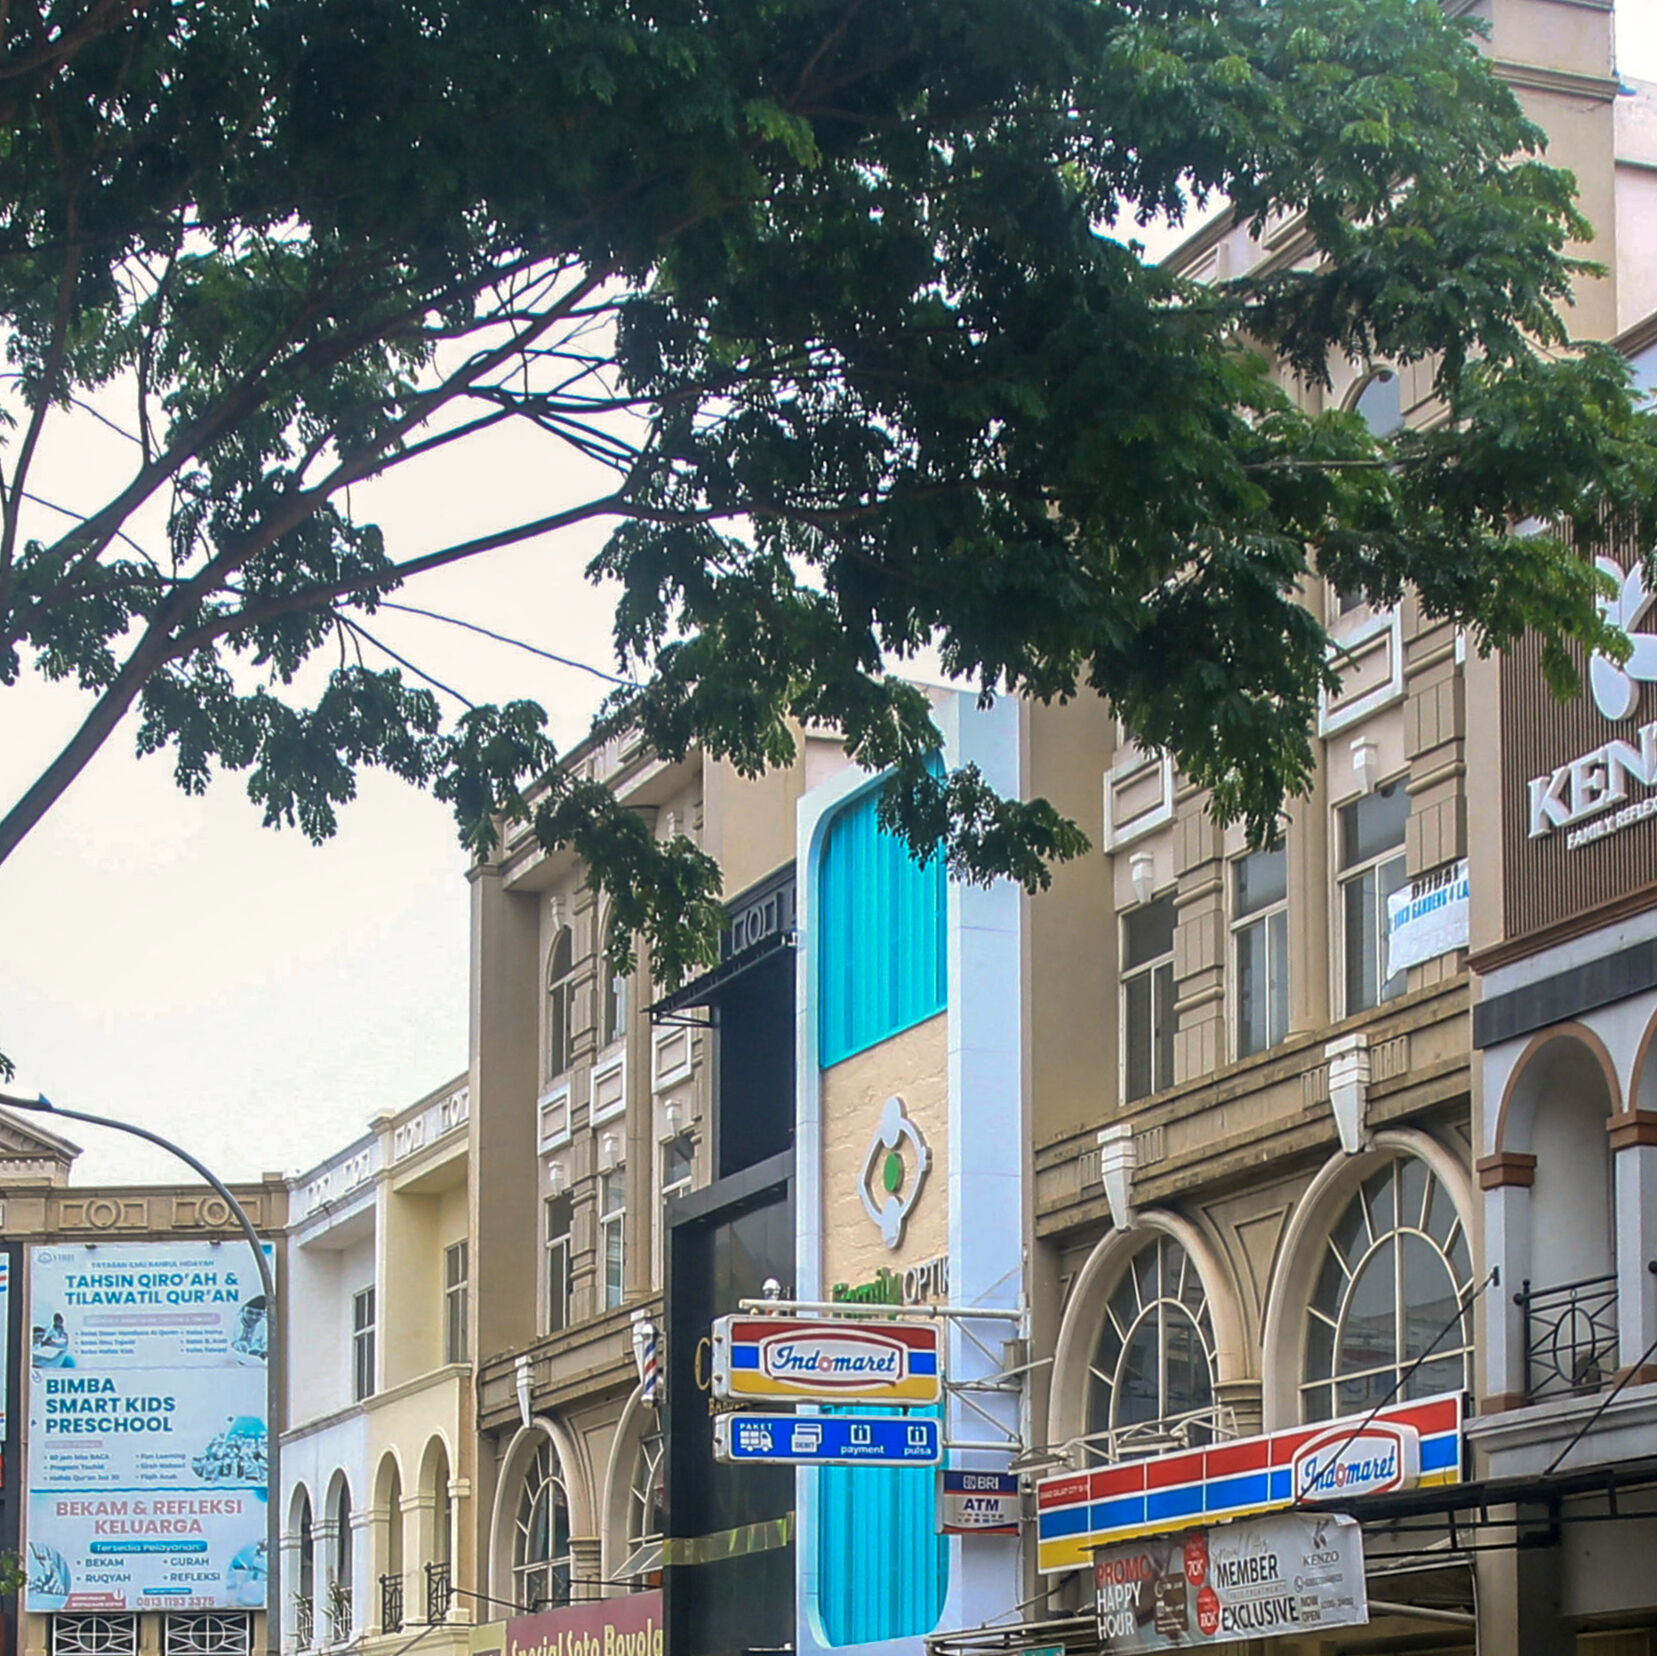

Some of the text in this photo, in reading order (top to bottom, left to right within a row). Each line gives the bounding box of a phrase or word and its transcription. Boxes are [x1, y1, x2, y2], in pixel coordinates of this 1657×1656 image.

[1566, 815, 1616, 850] FAMILY
[64, 1274, 134, 1290] TAHSIN
[224, 1272, 240, 1286] &
[64, 1289, 240, 1307] TILAWATIL QUR'AN
[770, 1345, 897, 1373] Indomaret
[46, 1378, 116, 1395] BIMBA
[45, 1396, 177, 1414] SMART KIDS
[45, 1417, 174, 1434] PRESCHOOL
[739, 1422, 773, 1432] PAKET
[794, 1440, 816, 1450] DEBIT
[840, 1444, 885, 1456] payment
[903, 1446, 932, 1456] pulsa
[1301, 1444, 1396, 1493] Indomaret
[977, 1476, 999, 1490] BRI
[55, 1499, 243, 1516] BEKAM & REFLEKSI
[963, 1497, 1000, 1512] ATM
[94, 1518, 203, 1535] KELUARGA
[85, 1558, 125, 1568] BEKAM
[1302, 1550, 1340, 1567] KENZO
[85, 1573, 132, 1583] RUQYAH
[170, 1572, 221, 1582] REFLEKSI
[1095, 1554, 1152, 1589] PROMO
[1216, 1553, 1279, 1589] MEMBER
[1097, 1580, 1142, 1614] HAPPY
[1220, 1596, 1300, 1633] EXCLUSIVE
[1097, 1611, 1135, 1641] HOUR
